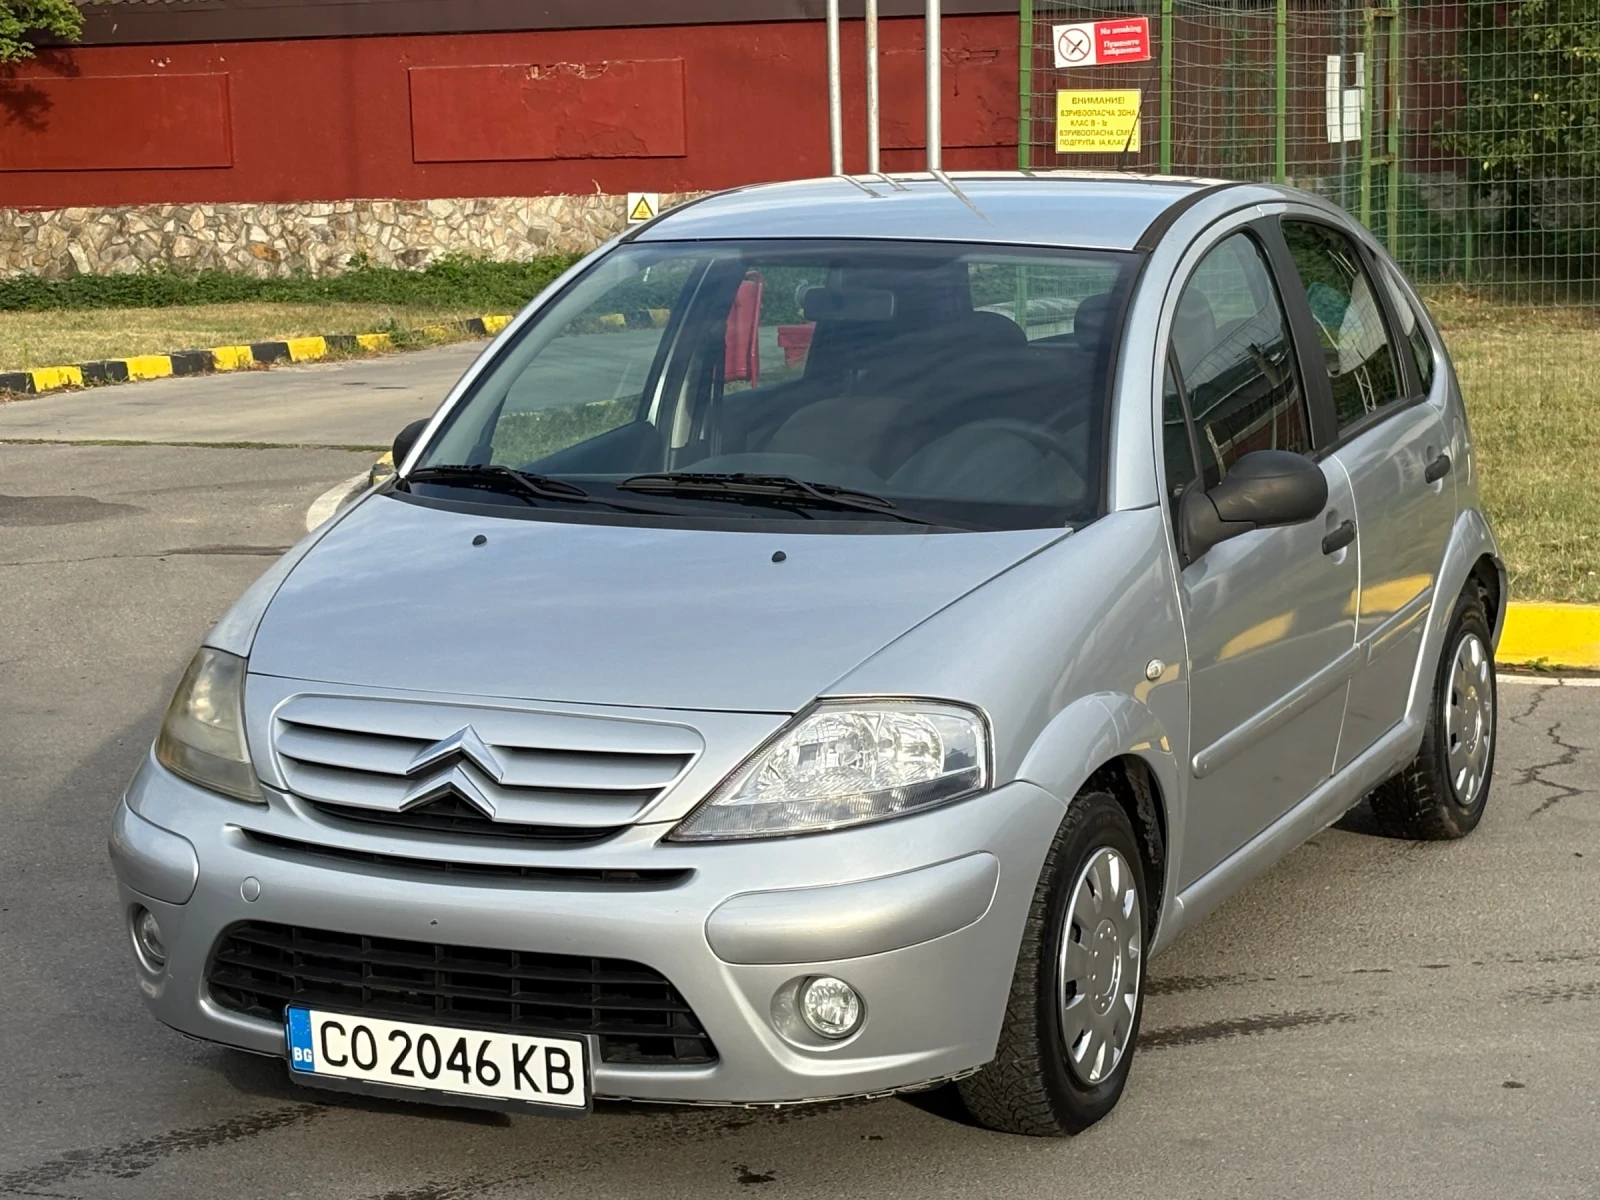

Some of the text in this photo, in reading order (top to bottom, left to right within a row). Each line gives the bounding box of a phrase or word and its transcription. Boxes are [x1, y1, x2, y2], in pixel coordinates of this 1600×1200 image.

[1100, 25, 1142, 35] No smoking
[1104, 40, 1140, 49] Пушенето
[1103, 47, 1141, 56] забранено
[1071, 96, 1125, 105] ВНИМАНИЕ!
[1117, 109, 1136, 117] ЗОНА
[1070, 119, 1089, 127] КЛАС
[1059, 129, 1114, 137] ВЗРИВООПАСНА
[1059, 139, 1096, 147] ПОДГРУПА
[294, 1046, 313, 1063] BG
[320, 1020, 575, 1095] CO 2046 KB
